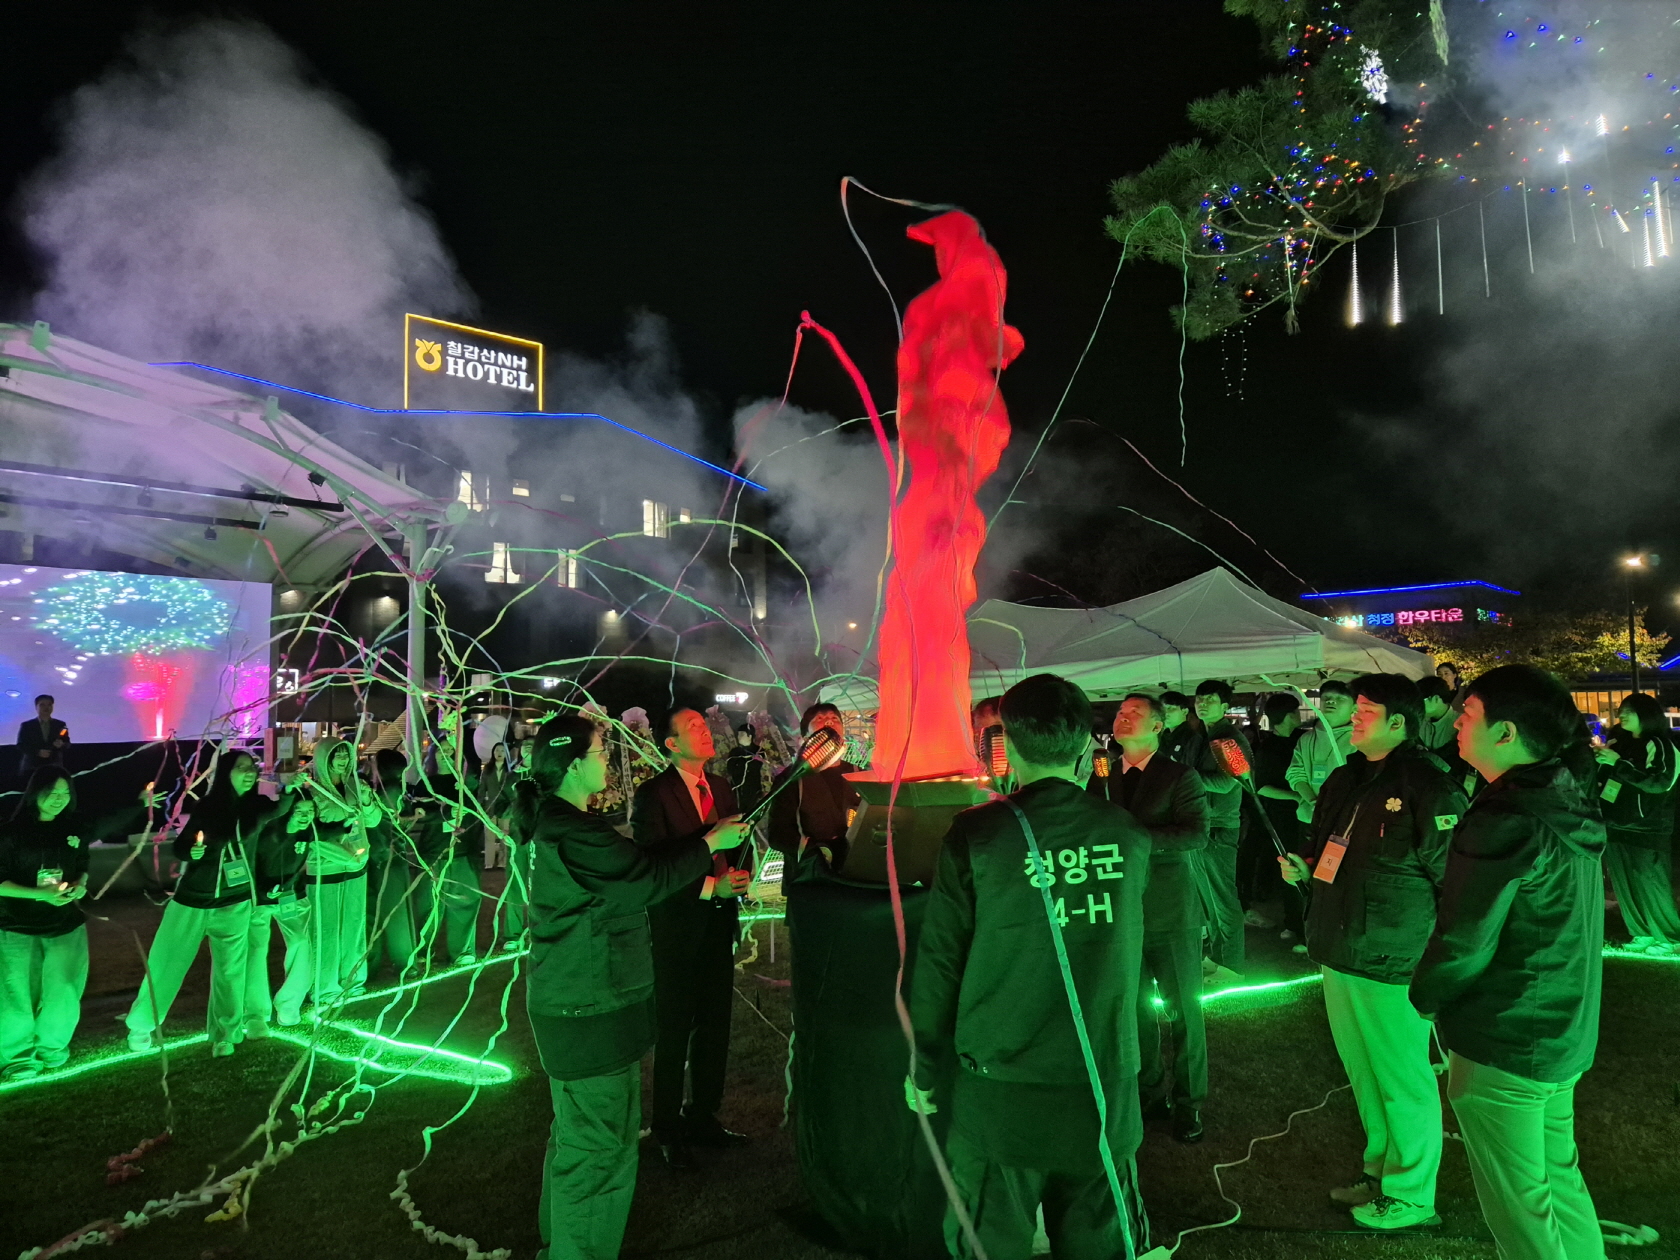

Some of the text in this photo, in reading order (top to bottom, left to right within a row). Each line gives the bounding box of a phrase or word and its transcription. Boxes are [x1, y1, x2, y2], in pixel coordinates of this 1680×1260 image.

[445, 356, 535, 392] HOTEL
[1367, 612, 1395, 626] 청정
[1397, 607, 1464, 625] 한우타운
[716, 694, 736, 703] COFFEE
[1024, 843, 1124, 888] 청양군
[1050, 892, 1113, 927] 4-H
